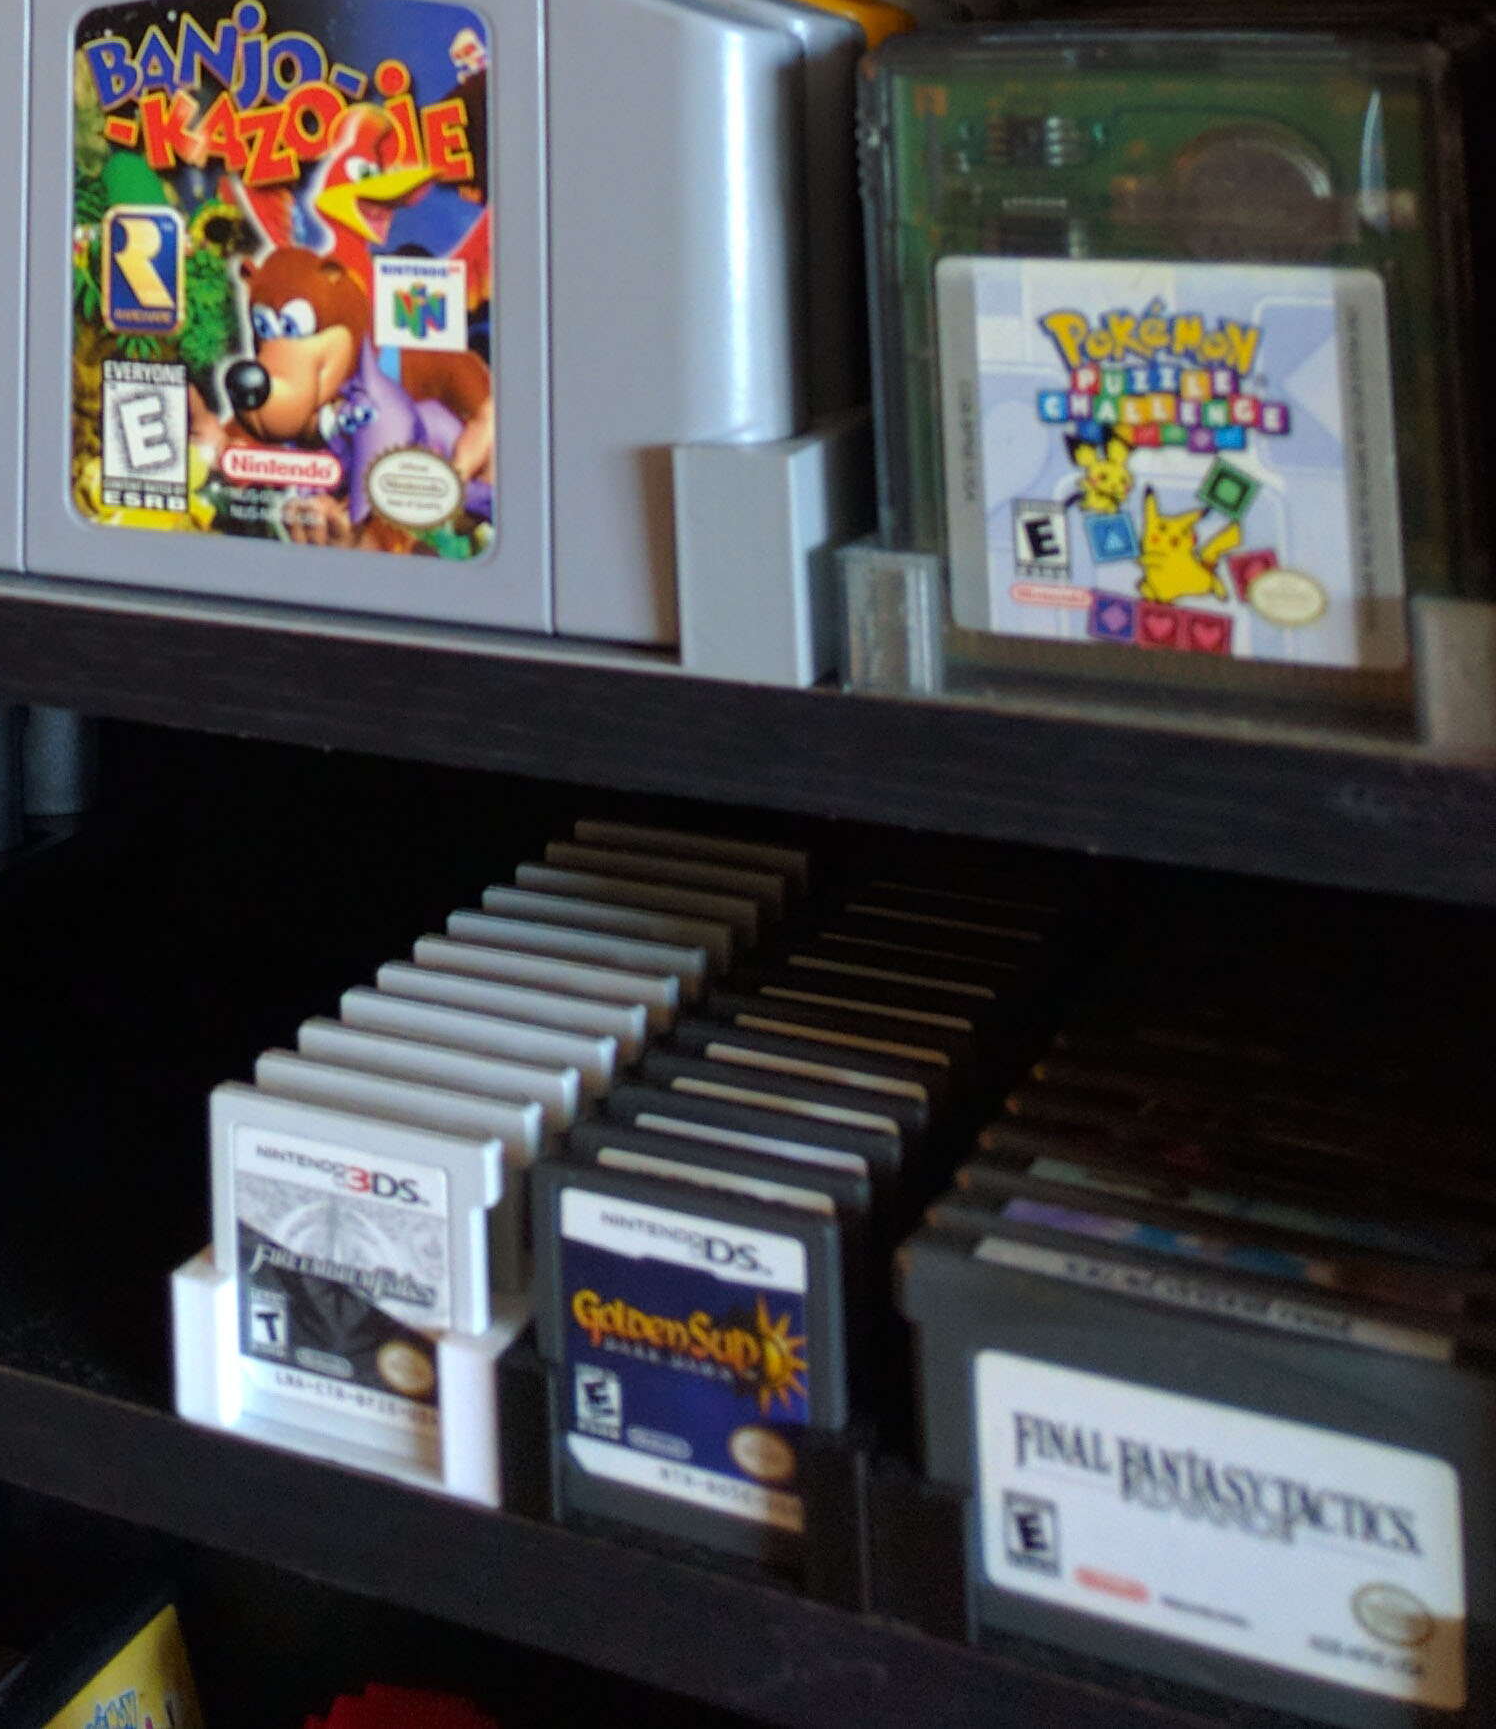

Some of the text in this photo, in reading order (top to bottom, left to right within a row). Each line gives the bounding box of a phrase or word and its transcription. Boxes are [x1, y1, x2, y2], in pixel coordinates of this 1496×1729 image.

[1071, 363, 1239, 398] PUZZLE
[119, 395, 173, 469] E
[1037, 390, 1289, 435] CHALLENGE
[231, 456, 330, 479] Nintendo
[1024, 517, 1060, 558] E
[256, 1309, 280, 1343] T
[1012, 1411, 1112, 1476] FINAL
[1116, 1435, 1273, 1510] FANTASY
[1271, 1475, 1423, 1557] TACTICS
[1014, 1508, 1050, 1553] E
